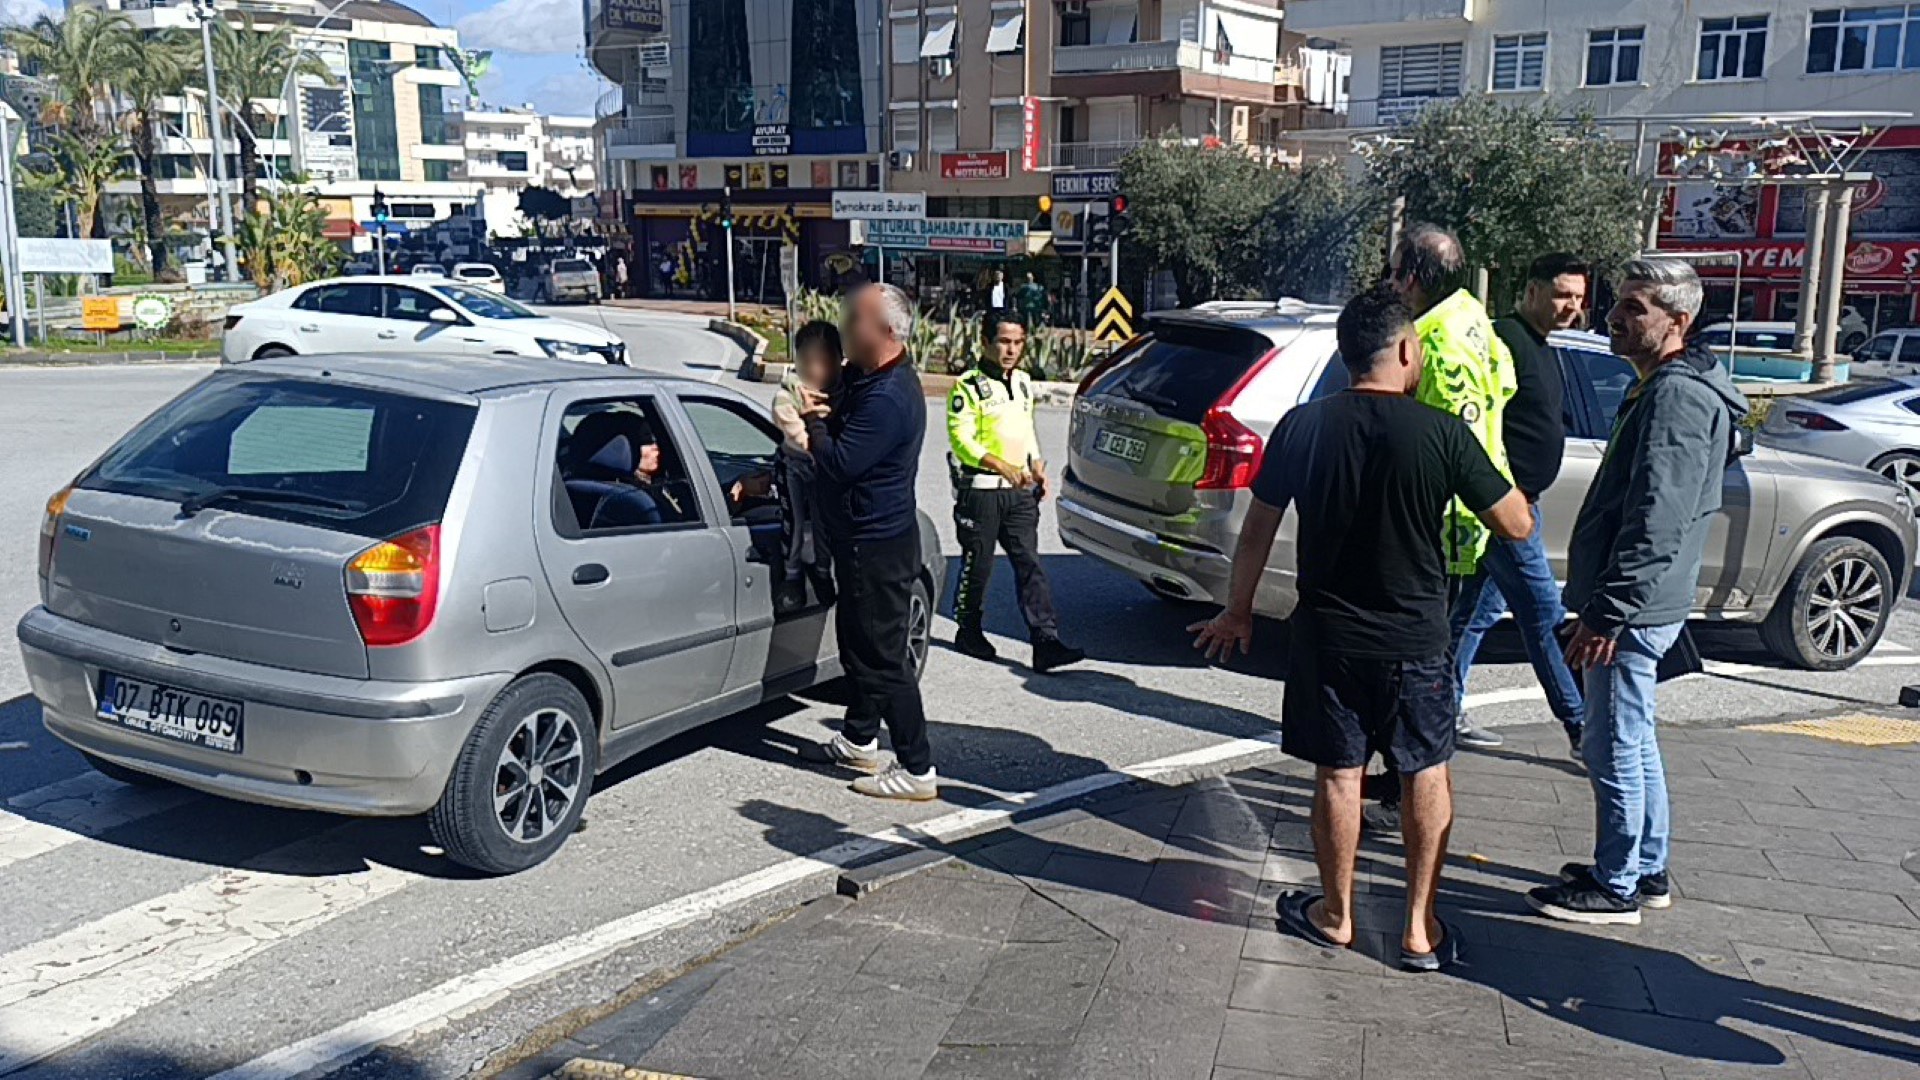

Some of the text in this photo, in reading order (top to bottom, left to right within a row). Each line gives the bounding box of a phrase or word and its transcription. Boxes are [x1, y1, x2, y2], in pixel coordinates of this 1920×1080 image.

[834, 199, 886, 212] Demokrasi
[920, 220, 971, 236] BAHARAT
[985, 222, 1025, 239] AKTAR
[1744, 247, 1806, 267] YEM
[114, 681, 238, 737] 07 BTK 069
